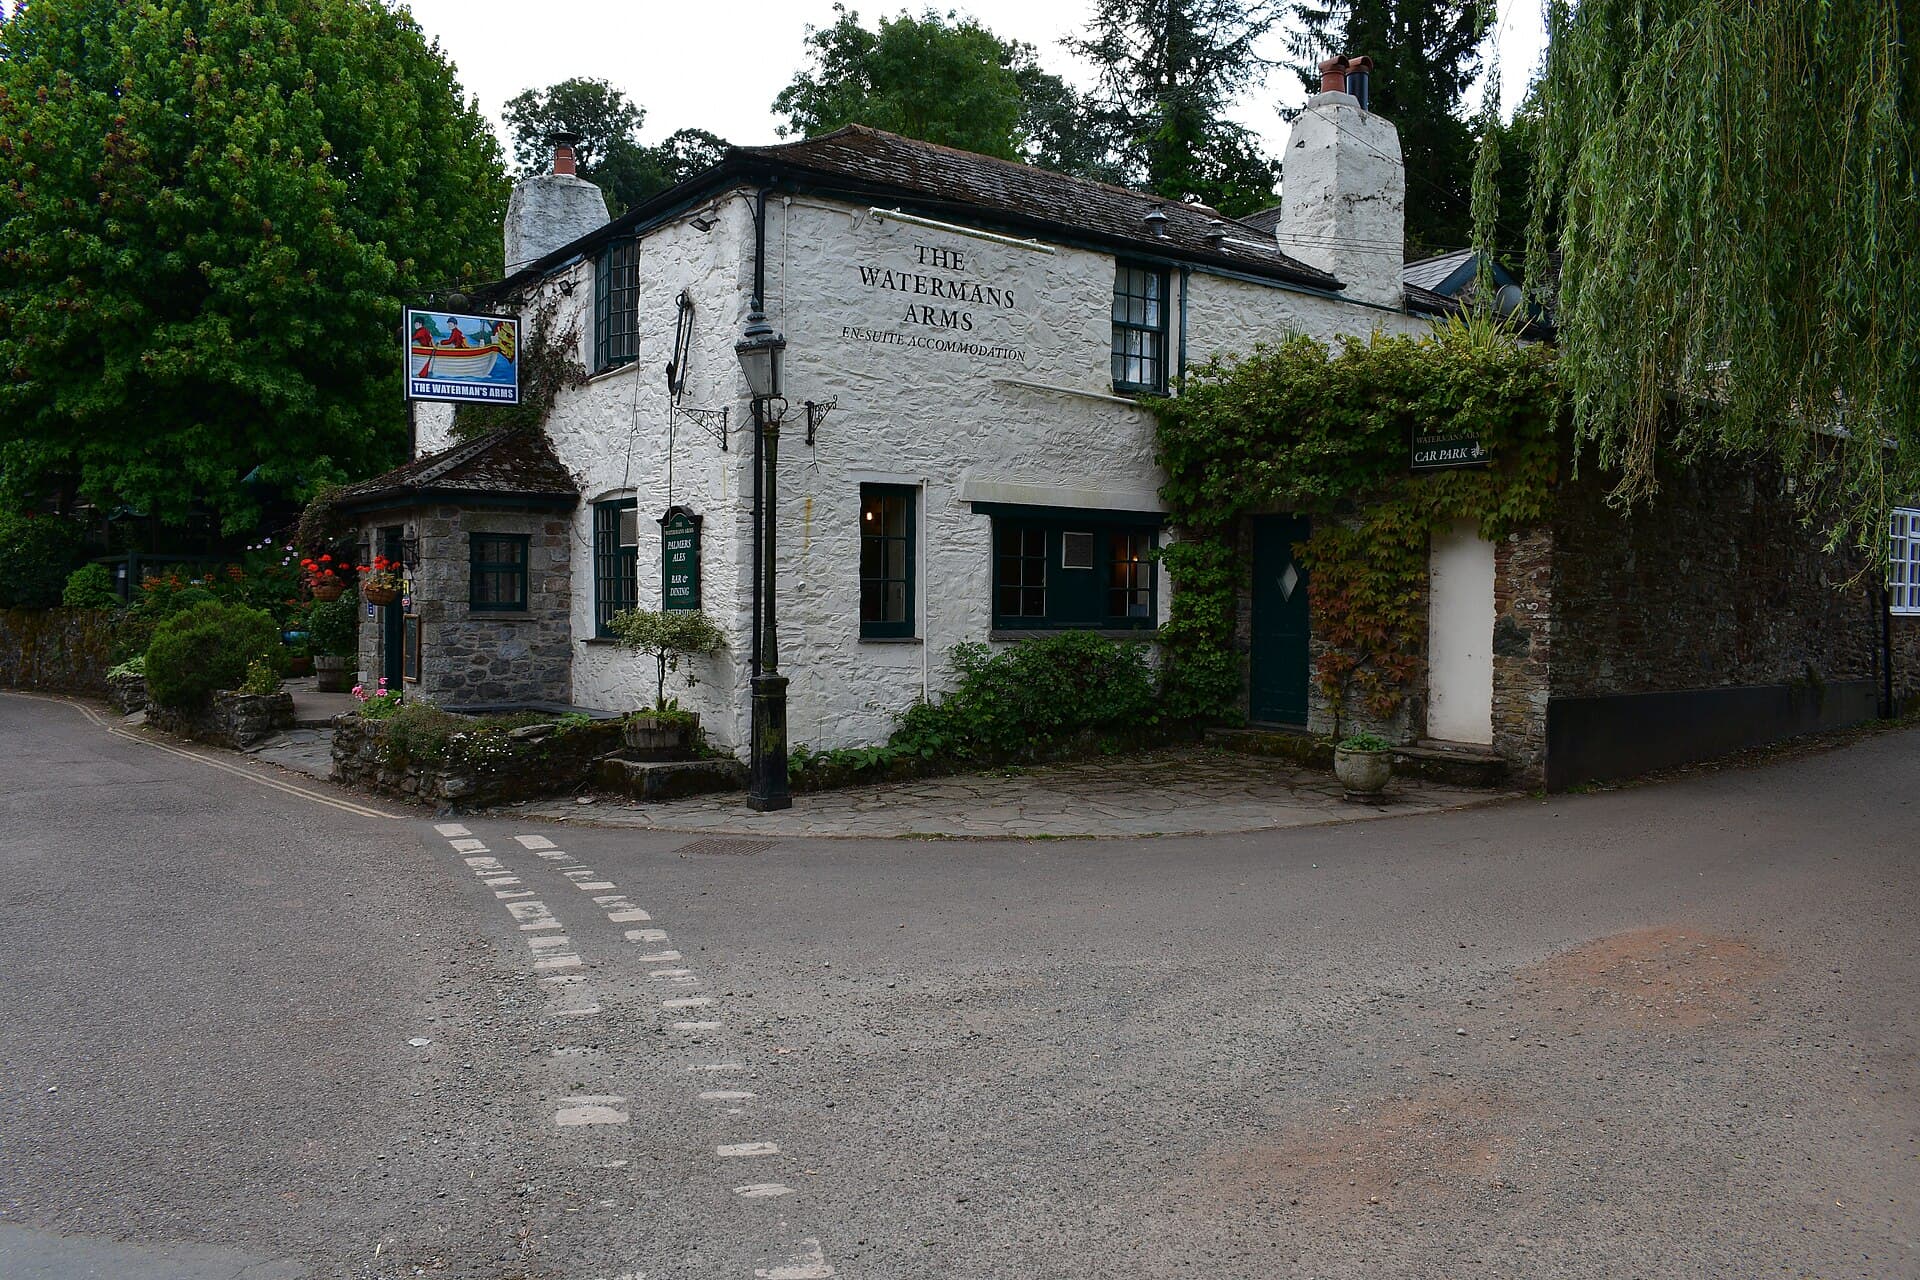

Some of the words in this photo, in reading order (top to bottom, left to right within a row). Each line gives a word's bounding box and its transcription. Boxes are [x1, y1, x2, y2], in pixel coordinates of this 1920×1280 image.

[914, 244, 965, 271] THE
[858, 265, 1015, 309] WATERMANS
[903, 303, 973, 332] ARMS
[842, 326, 904, 346] EN-SUITE
[907, 335, 1026, 362] ACCOMMODATION
[414, 382, 431, 393] THE
[432, 383, 488, 397] WATERMAN'S
[489, 387, 514, 399] ARMS
[1414, 451, 1438, 462] CAR
[1439, 447, 1469, 460] PARK
[667, 539, 692, 550] PALMERS
[672, 552, 686, 562] ALES
[671, 574, 682, 584] BAR
[682, 574, 689, 583] &
[669, 586, 690, 597] DINING
